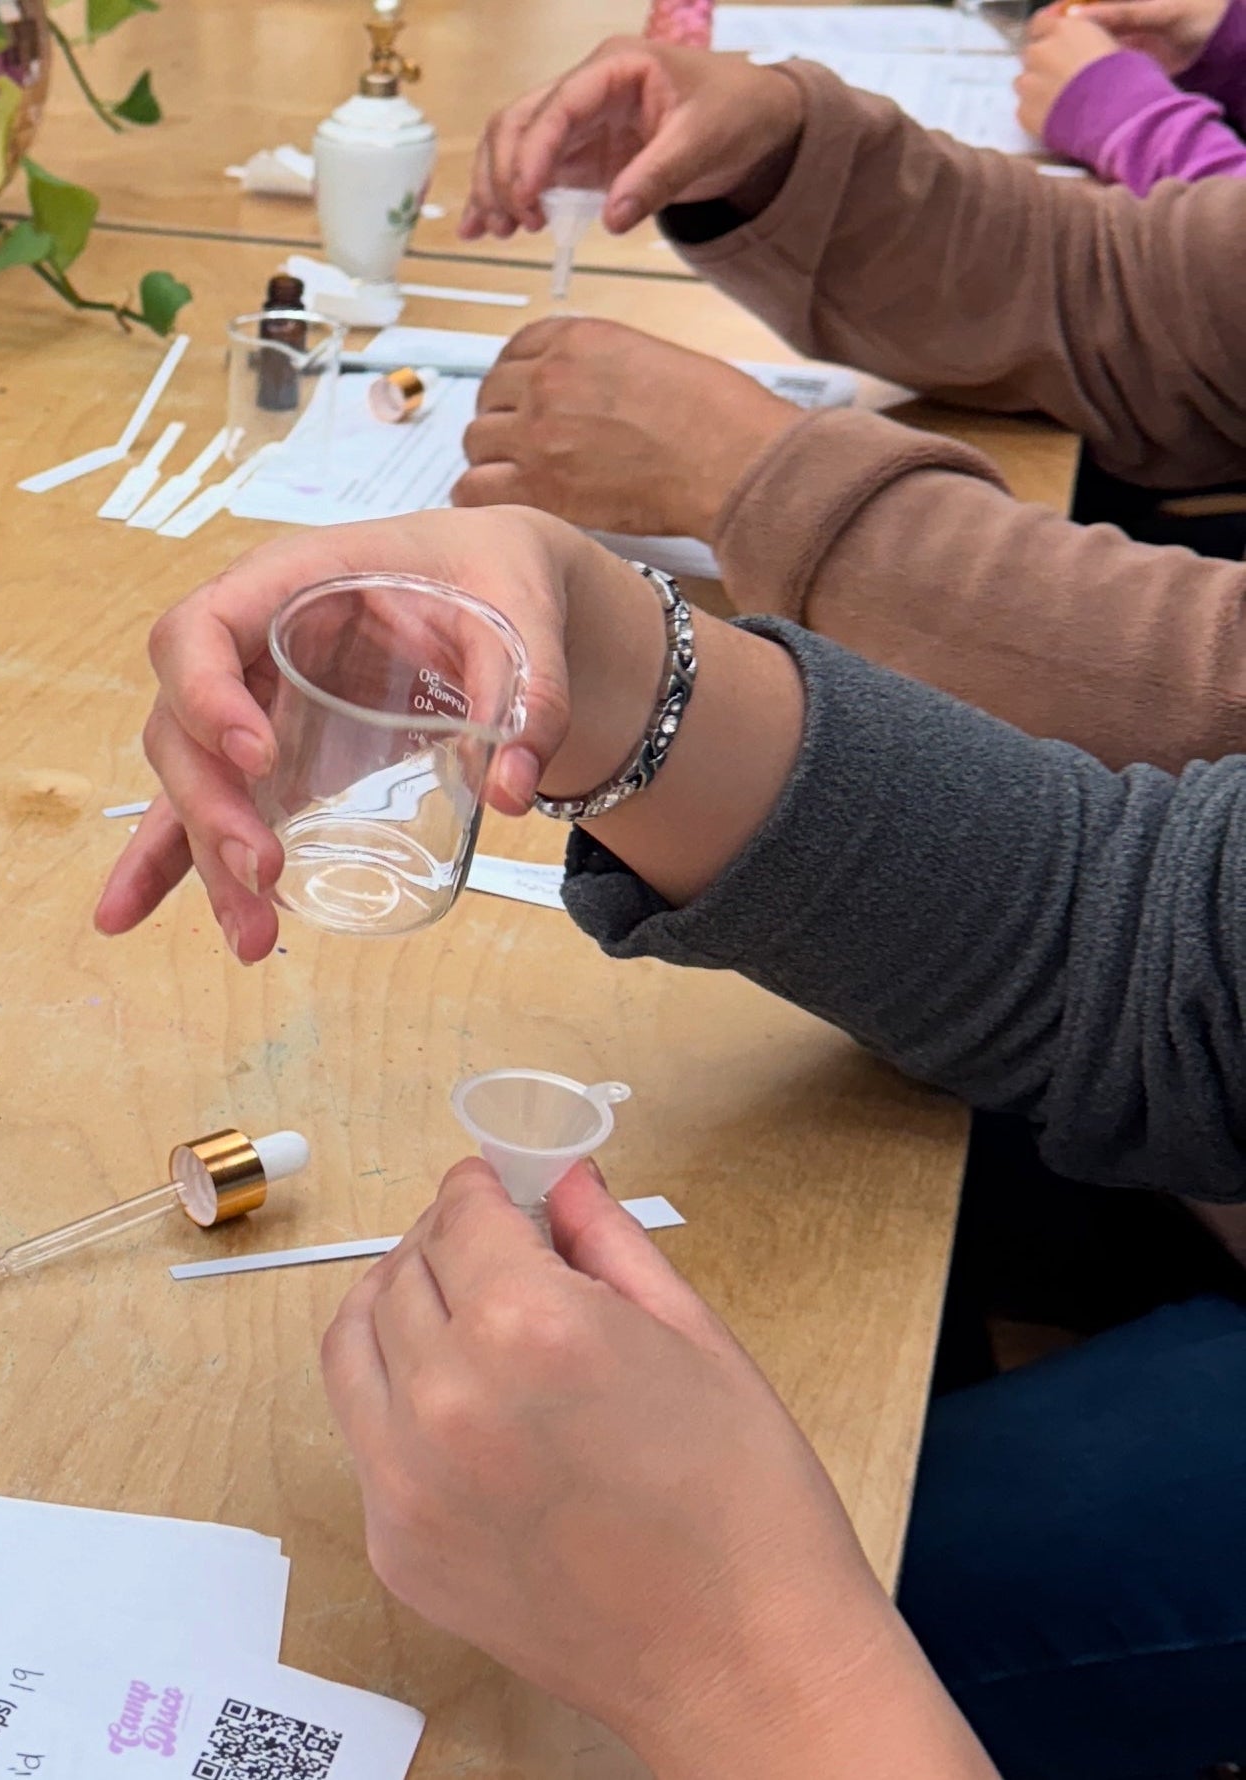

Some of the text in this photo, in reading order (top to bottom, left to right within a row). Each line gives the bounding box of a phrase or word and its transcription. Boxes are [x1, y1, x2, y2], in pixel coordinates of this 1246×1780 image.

[9, 1668, 44, 1692] 19
[108, 1680, 158, 1755] Camp
[143, 1687, 184, 1757] Disco
